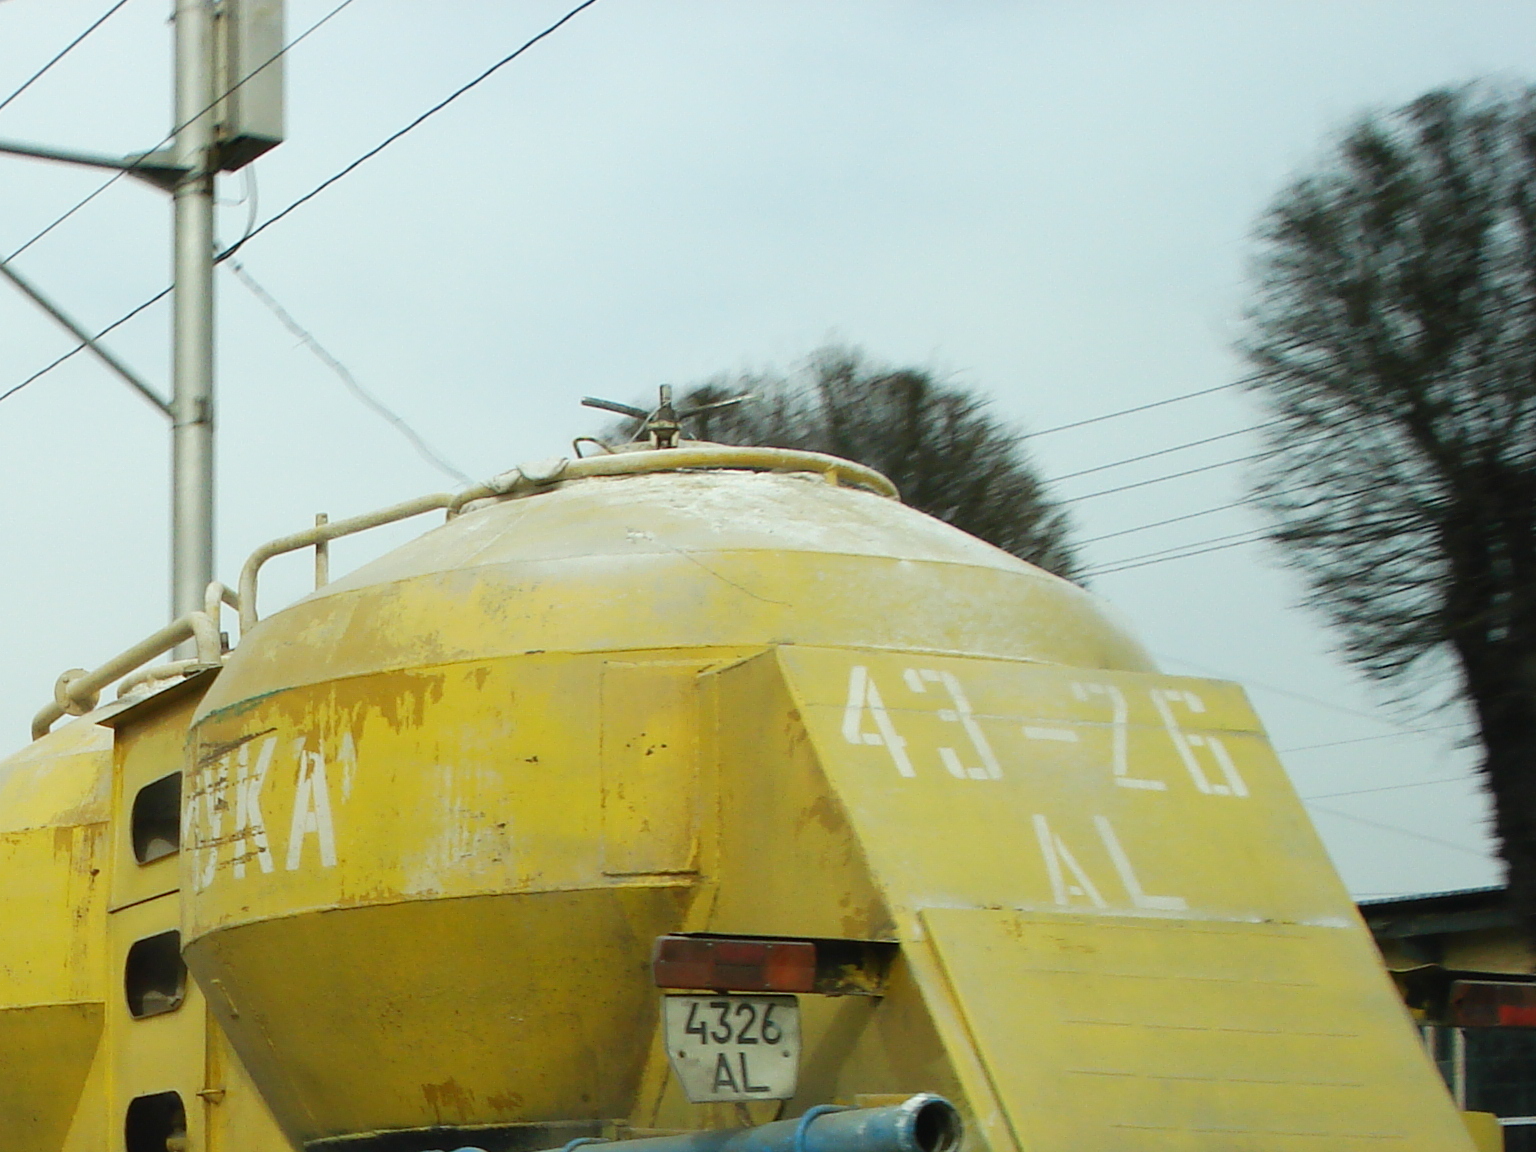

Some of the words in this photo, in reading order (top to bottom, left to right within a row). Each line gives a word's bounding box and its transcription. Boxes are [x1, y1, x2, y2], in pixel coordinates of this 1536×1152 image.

[1032, 813, 1189, 910] AL
[685, 1001, 783, 1045] 4326
[712, 1052, 771, 1093] AL
